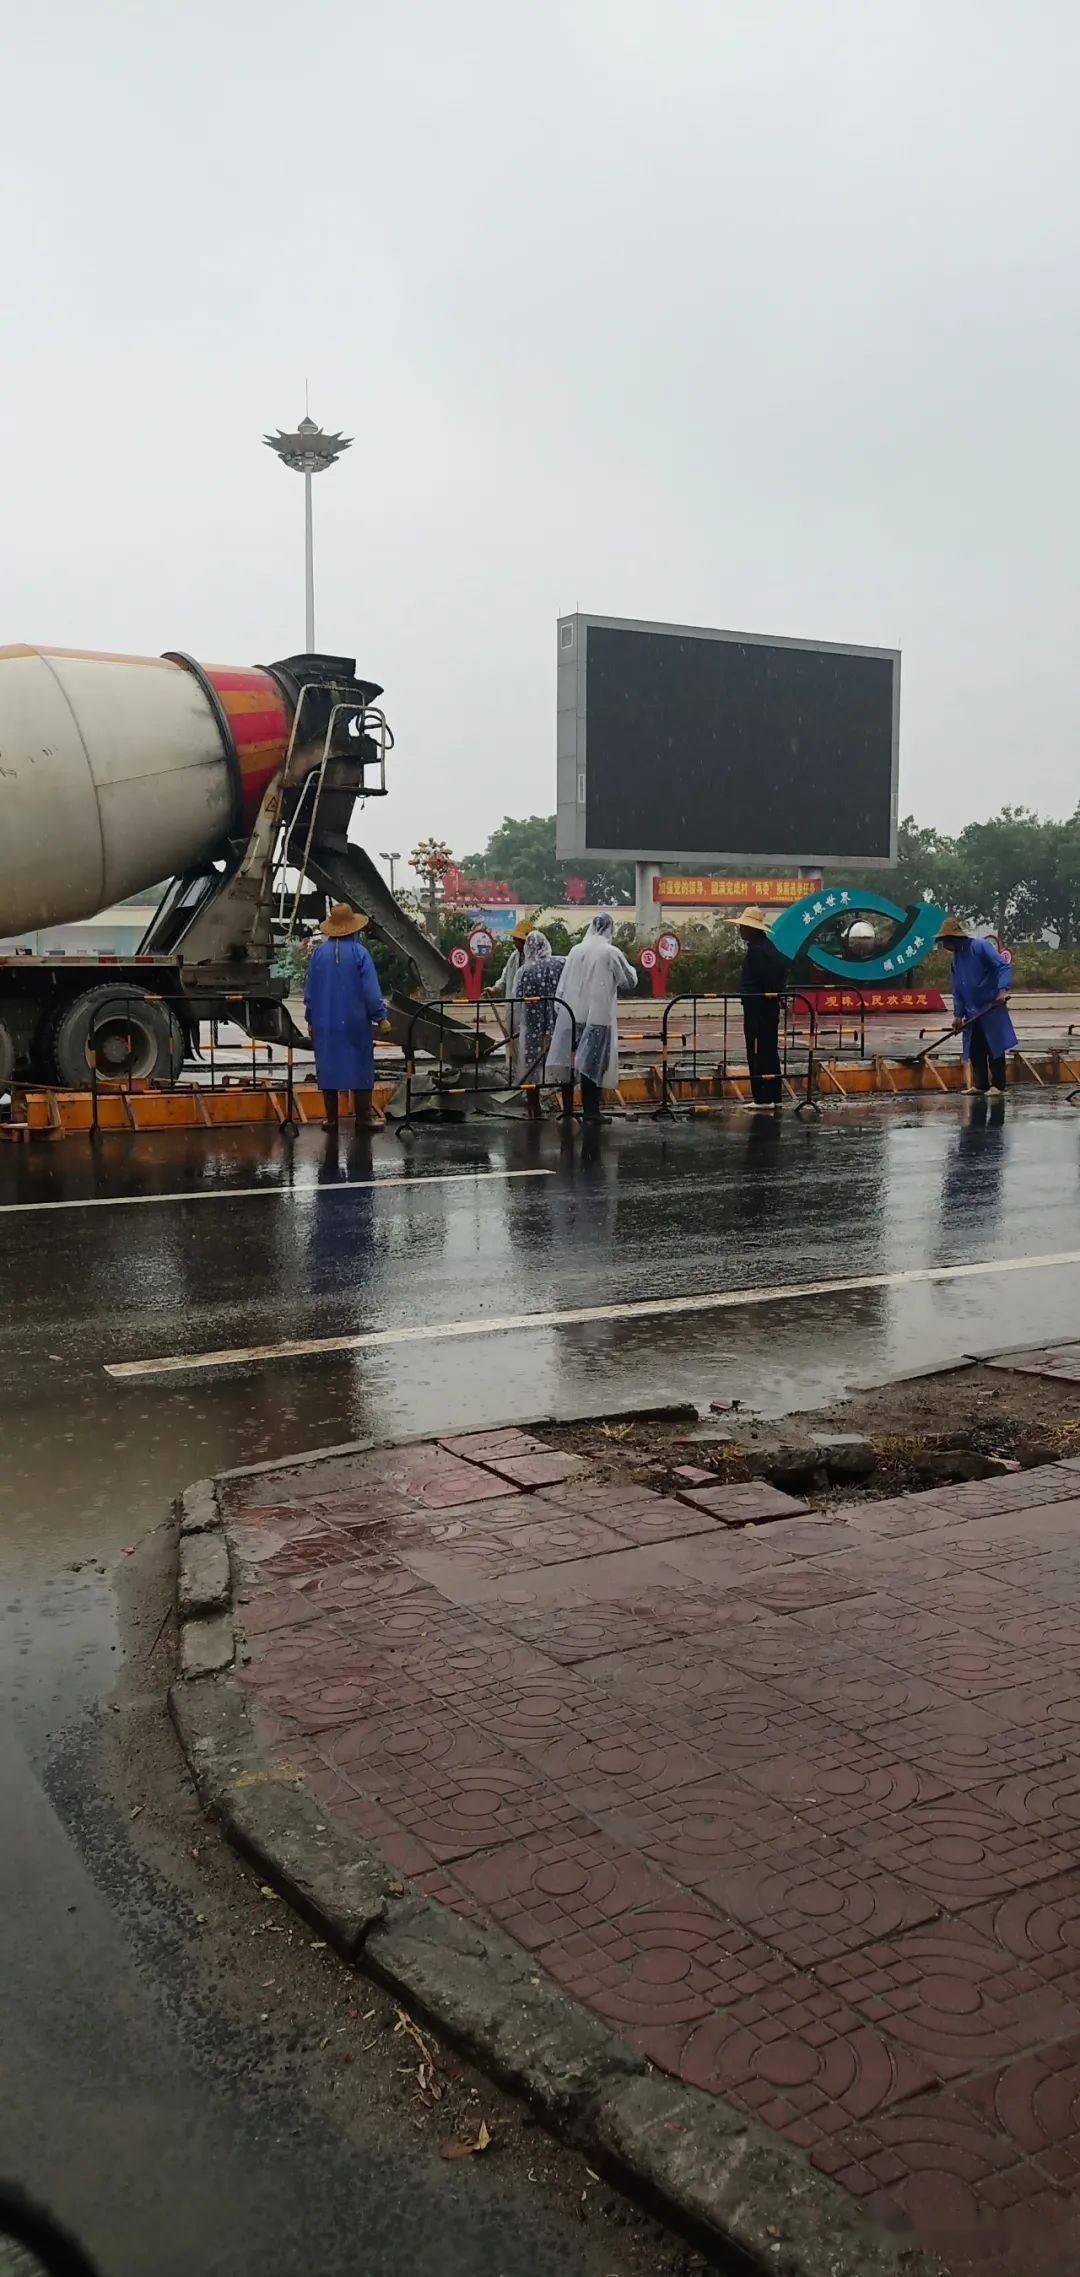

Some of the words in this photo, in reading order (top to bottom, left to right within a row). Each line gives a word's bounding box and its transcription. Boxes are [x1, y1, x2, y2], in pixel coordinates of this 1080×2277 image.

[802, 891, 851, 925] 放眼世界
[824, 993, 929, 1007] 观珠人民欢迎您
